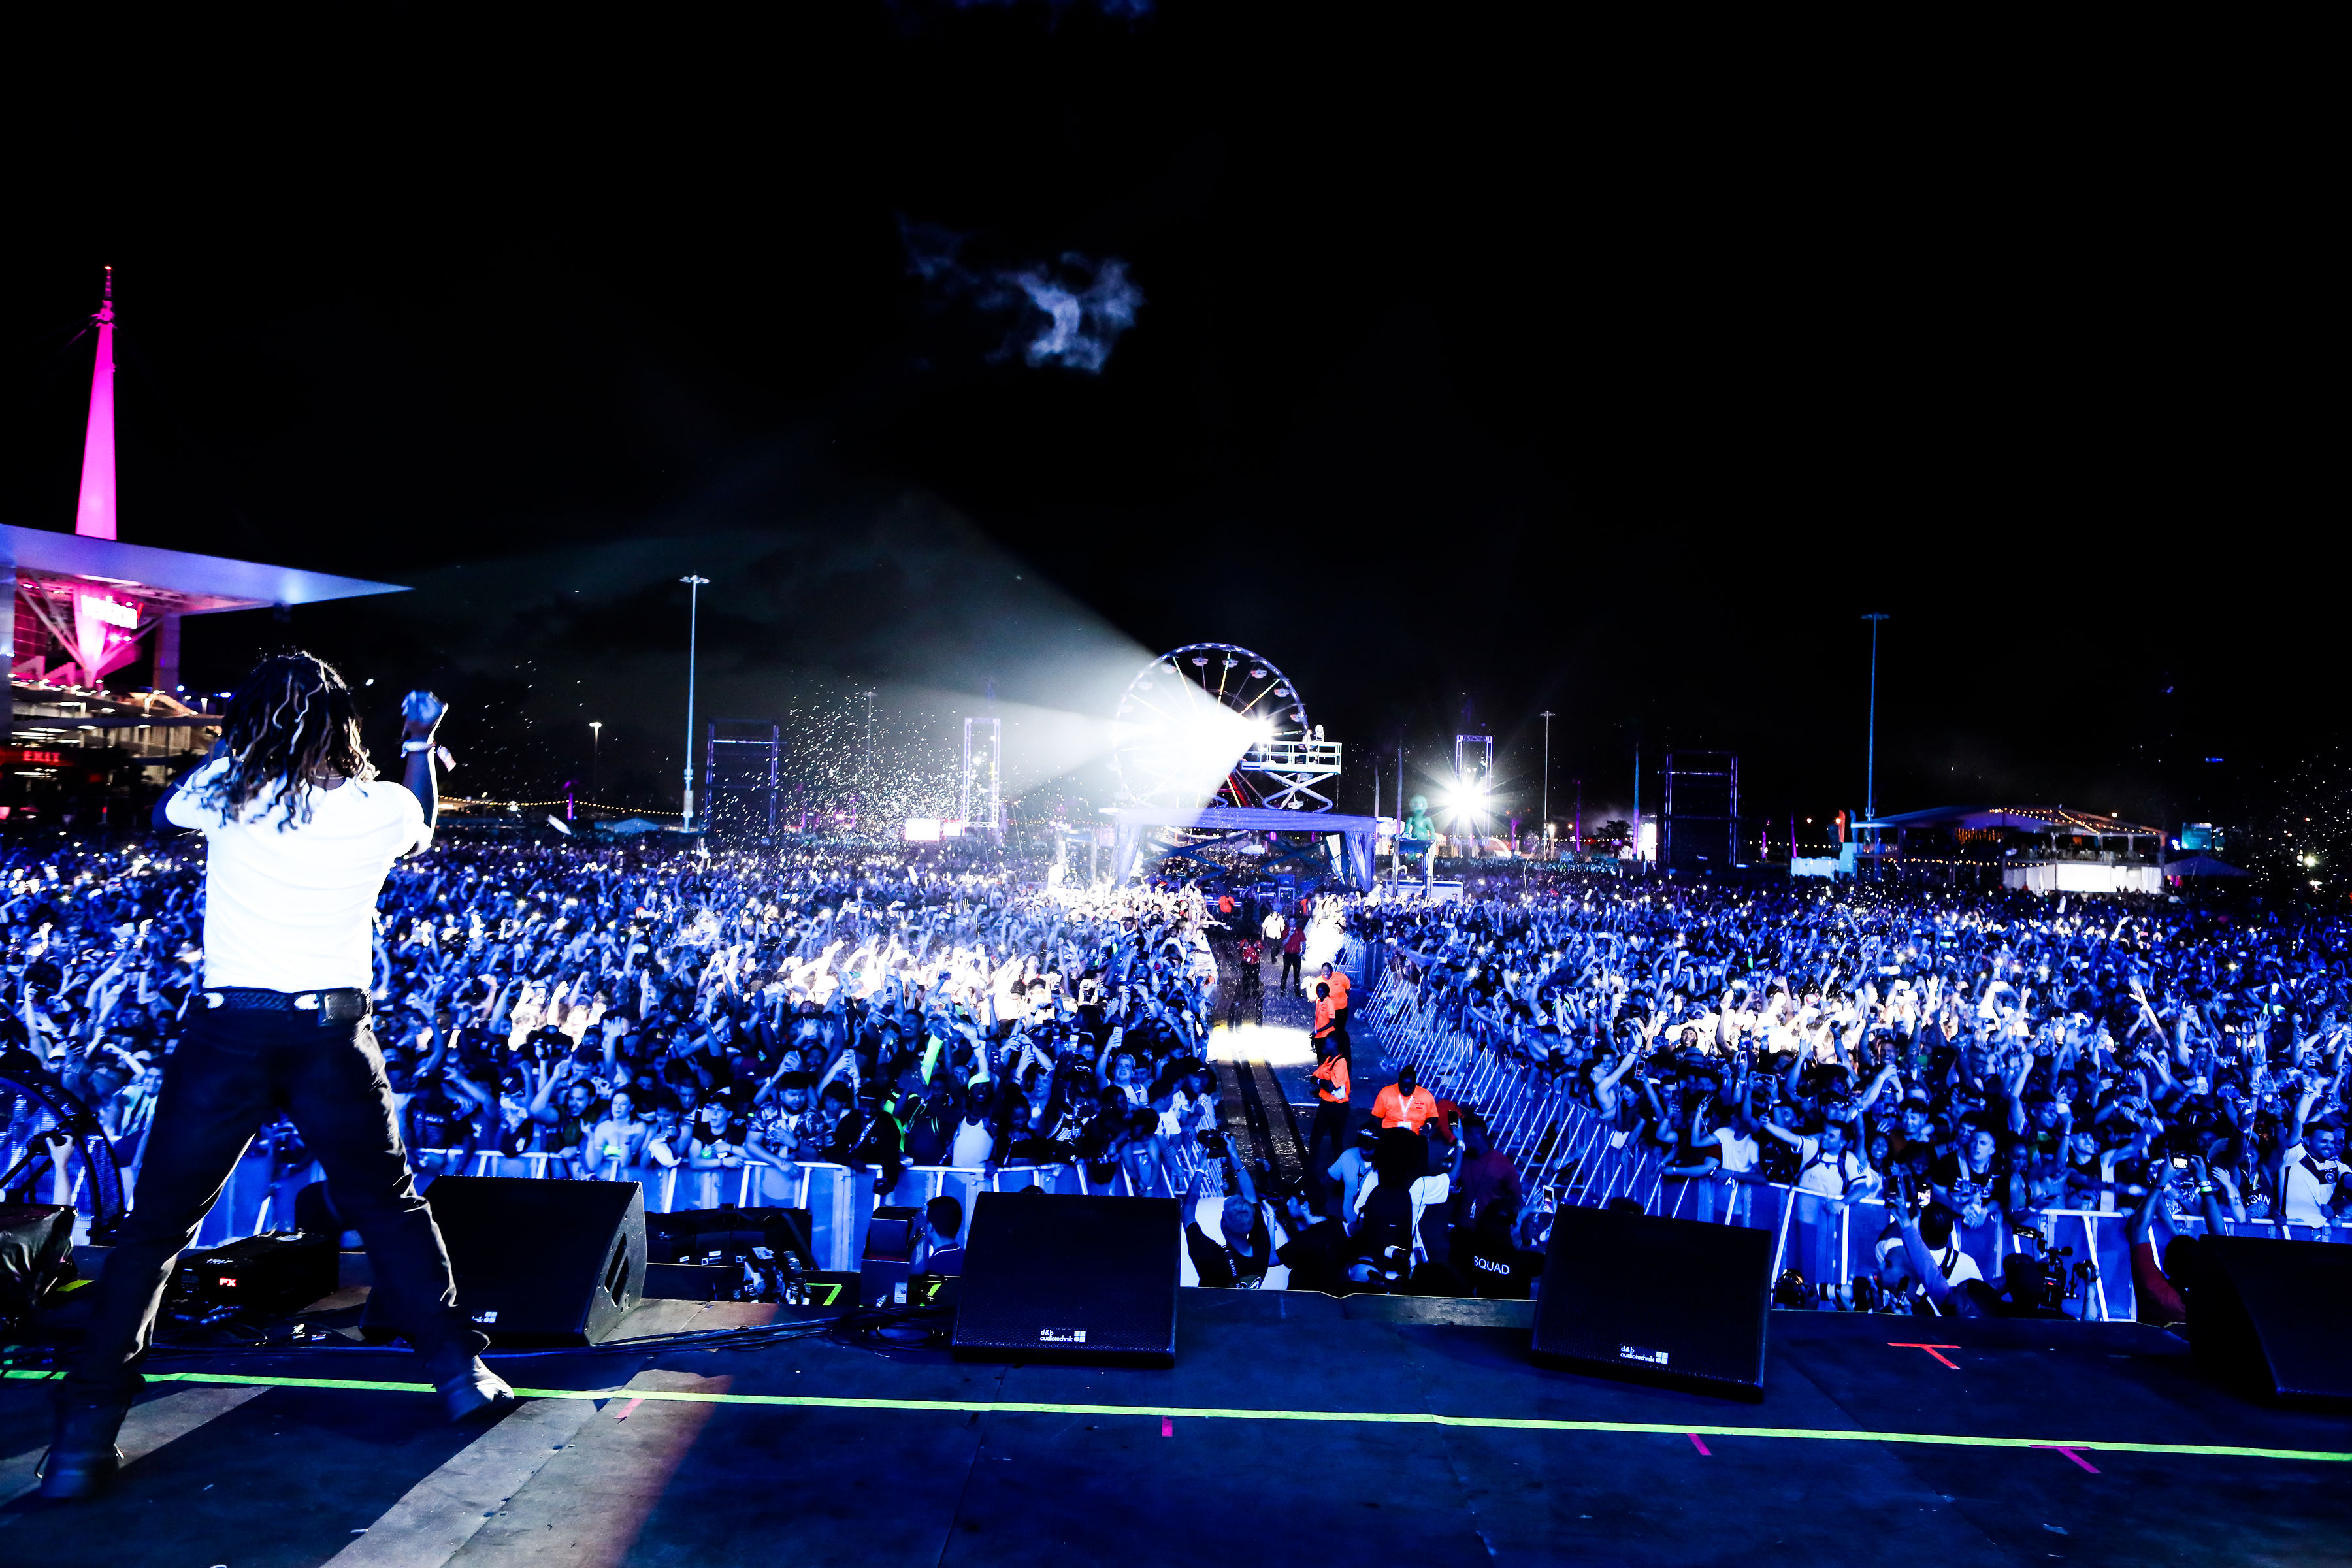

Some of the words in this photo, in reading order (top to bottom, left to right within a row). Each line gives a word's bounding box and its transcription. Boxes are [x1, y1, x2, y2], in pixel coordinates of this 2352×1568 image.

[23, 750, 60, 762] EXIT
[1474, 1256, 1510, 1275] SQUAD
[219, 1277, 237, 1287] FX
